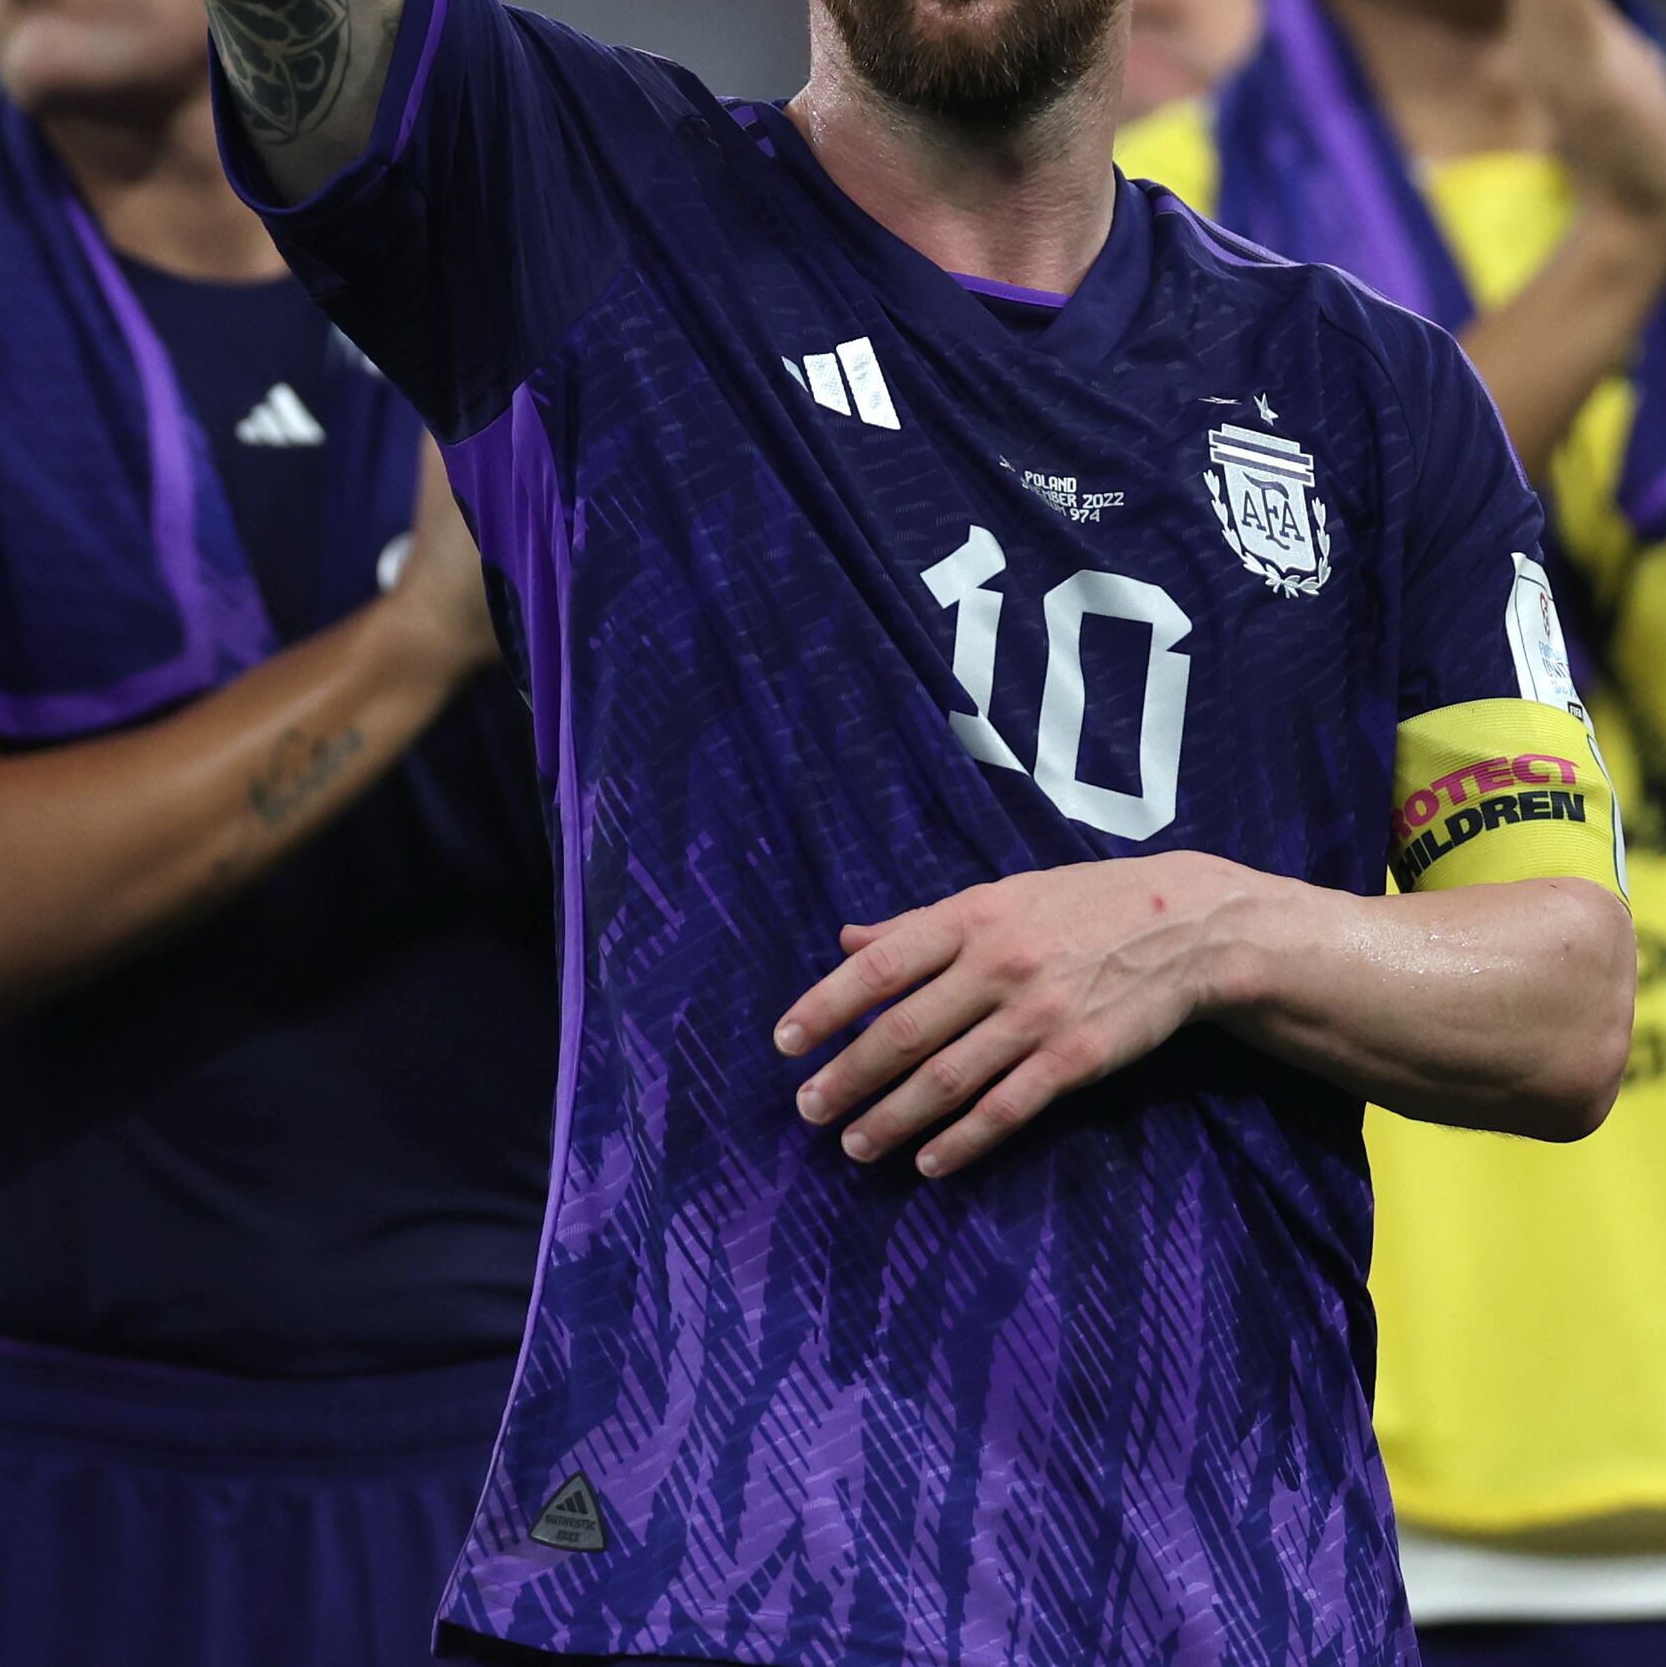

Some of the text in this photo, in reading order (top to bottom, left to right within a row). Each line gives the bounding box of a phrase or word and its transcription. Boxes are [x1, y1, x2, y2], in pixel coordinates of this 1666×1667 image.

[1024, 470, 1077, 493] POLAND
[1082, 492, 1125, 509] 2022
[1069, 508, 1101, 523] 974
[1241, 470, 1306, 551] AFA
[919, 524, 1193, 841] 10
[1395, 790, 1586, 889] HILDREN
